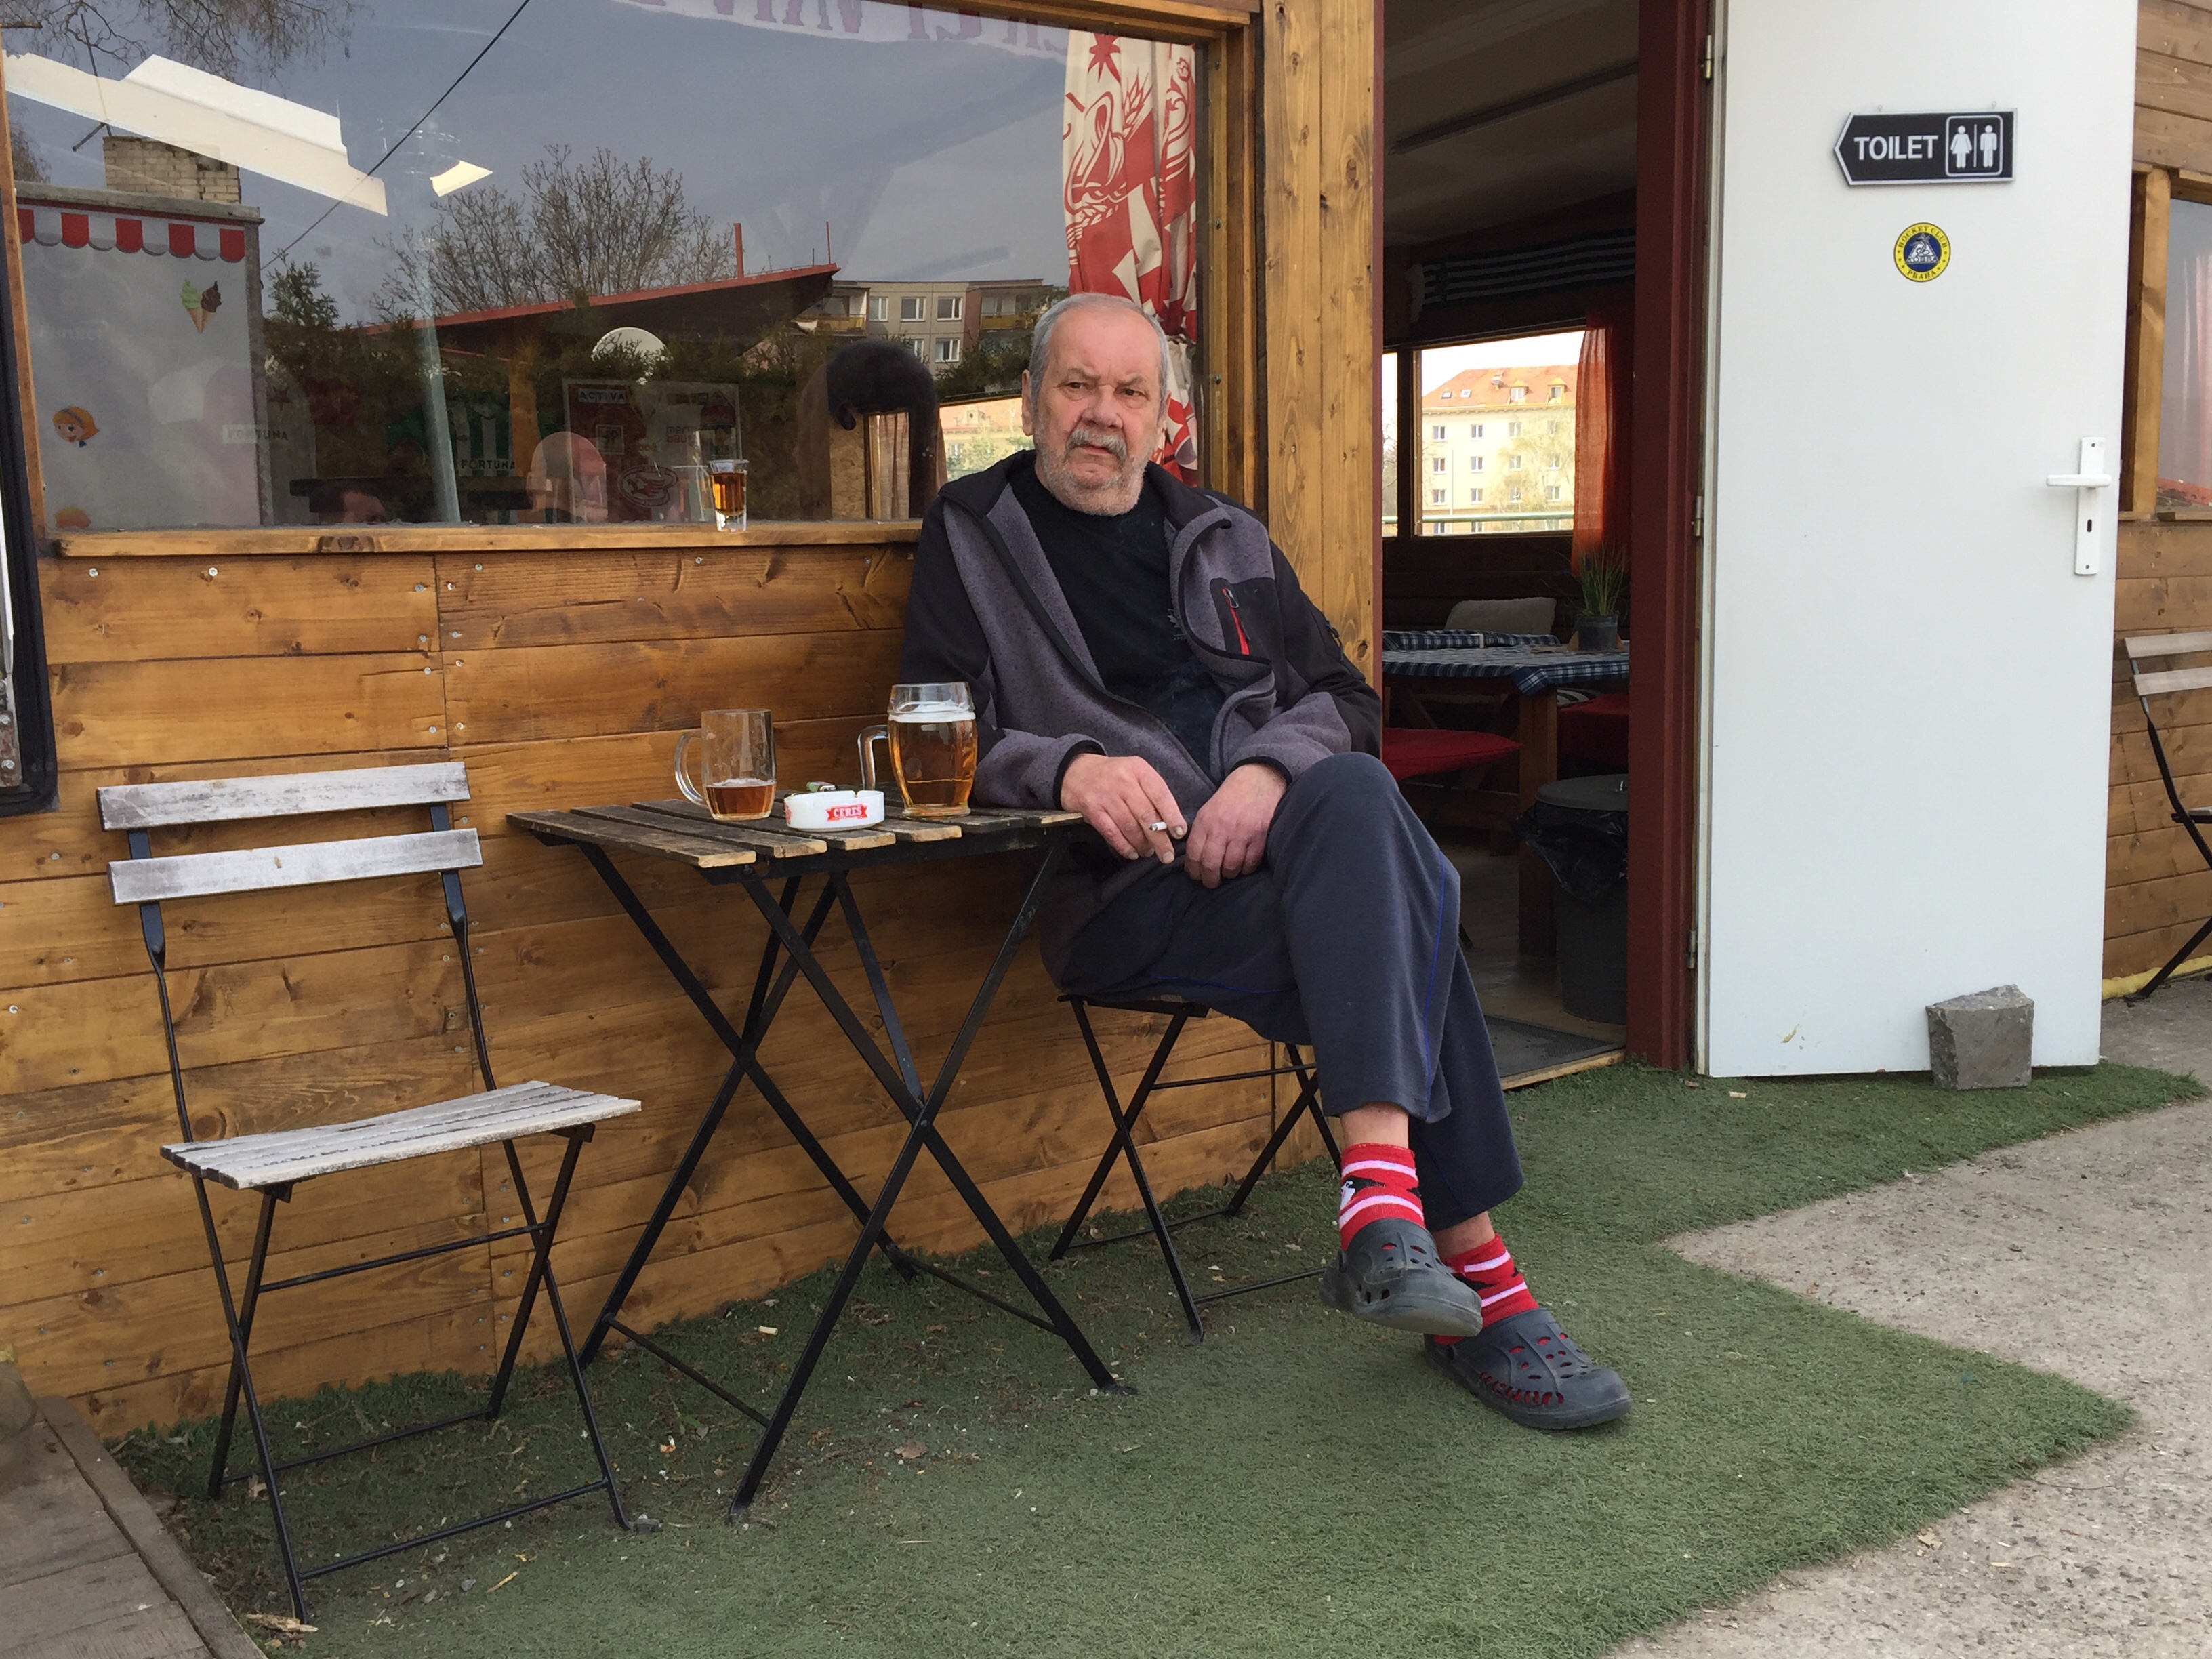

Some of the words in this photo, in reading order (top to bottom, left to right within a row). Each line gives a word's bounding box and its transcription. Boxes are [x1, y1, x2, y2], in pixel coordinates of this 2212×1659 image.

[1854, 136, 1938, 160] TOILET
[1898, 226, 1929, 248] HOCKEY
[1930, 228, 1948, 248] CLUB
[1906, 270, 1936, 279] PRAHA
[580, 391, 625, 401] ACTIVA
[228, 428, 289, 441] FORTUNA
[461, 459, 515, 470] FORTUNA
[834, 806, 862, 817] CERES
